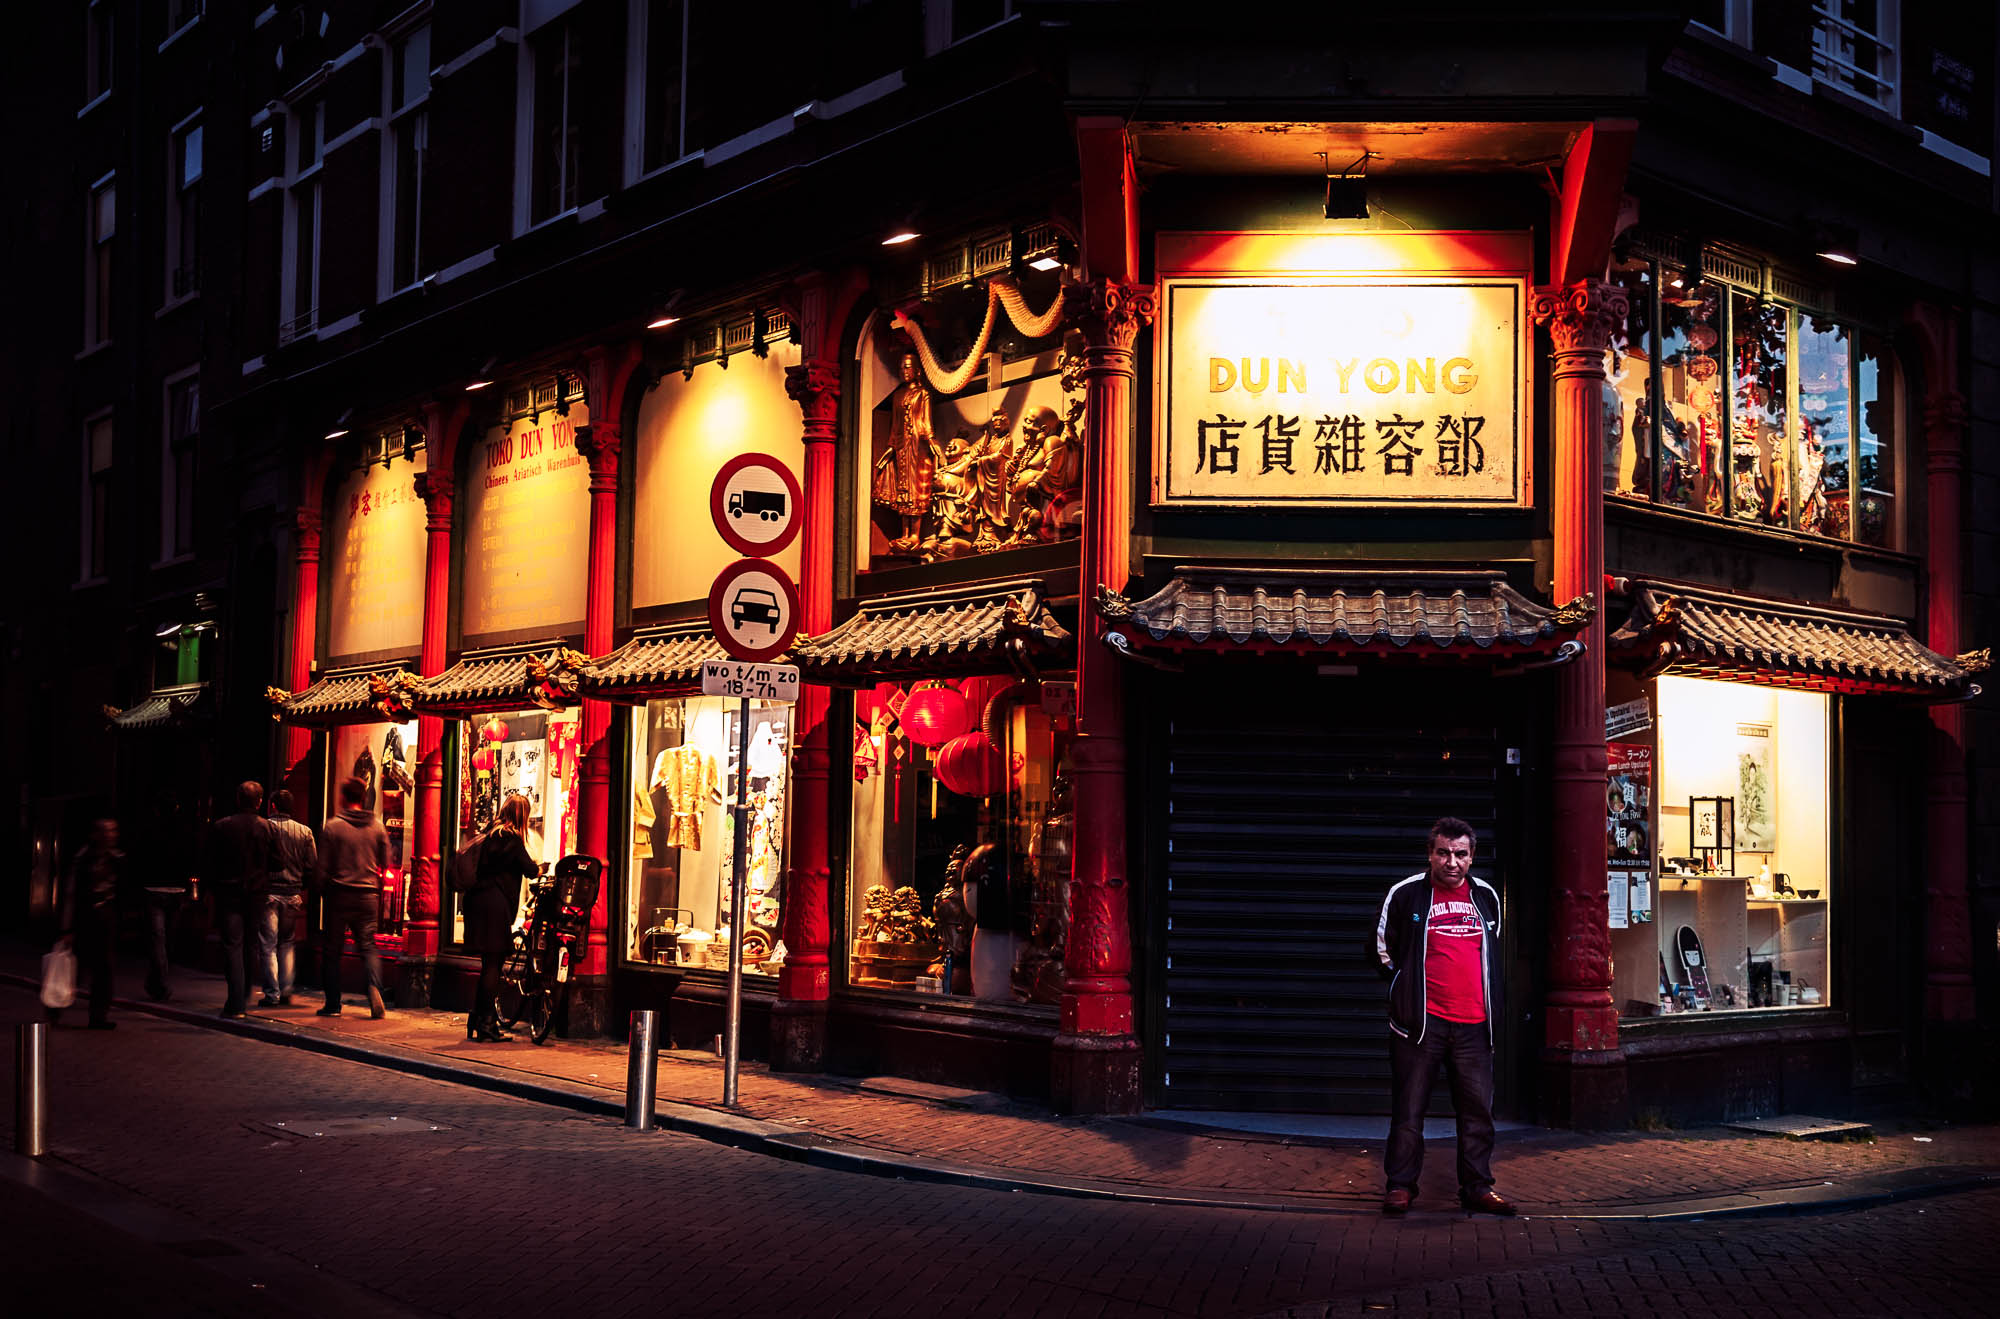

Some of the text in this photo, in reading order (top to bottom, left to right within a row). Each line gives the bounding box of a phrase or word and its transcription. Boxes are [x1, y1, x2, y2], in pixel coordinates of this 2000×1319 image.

[1209, 356, 1479, 394] DUN YONG
[486, 437, 513, 469] TOKO
[520, 427, 544, 460] DUN
[485, 472, 509, 489] Chinees
[514, 462, 542, 481] Aziatisch
[707, 665, 797, 683] wo t/m zo
[1627, 748, 1650, 761] ラーメン
